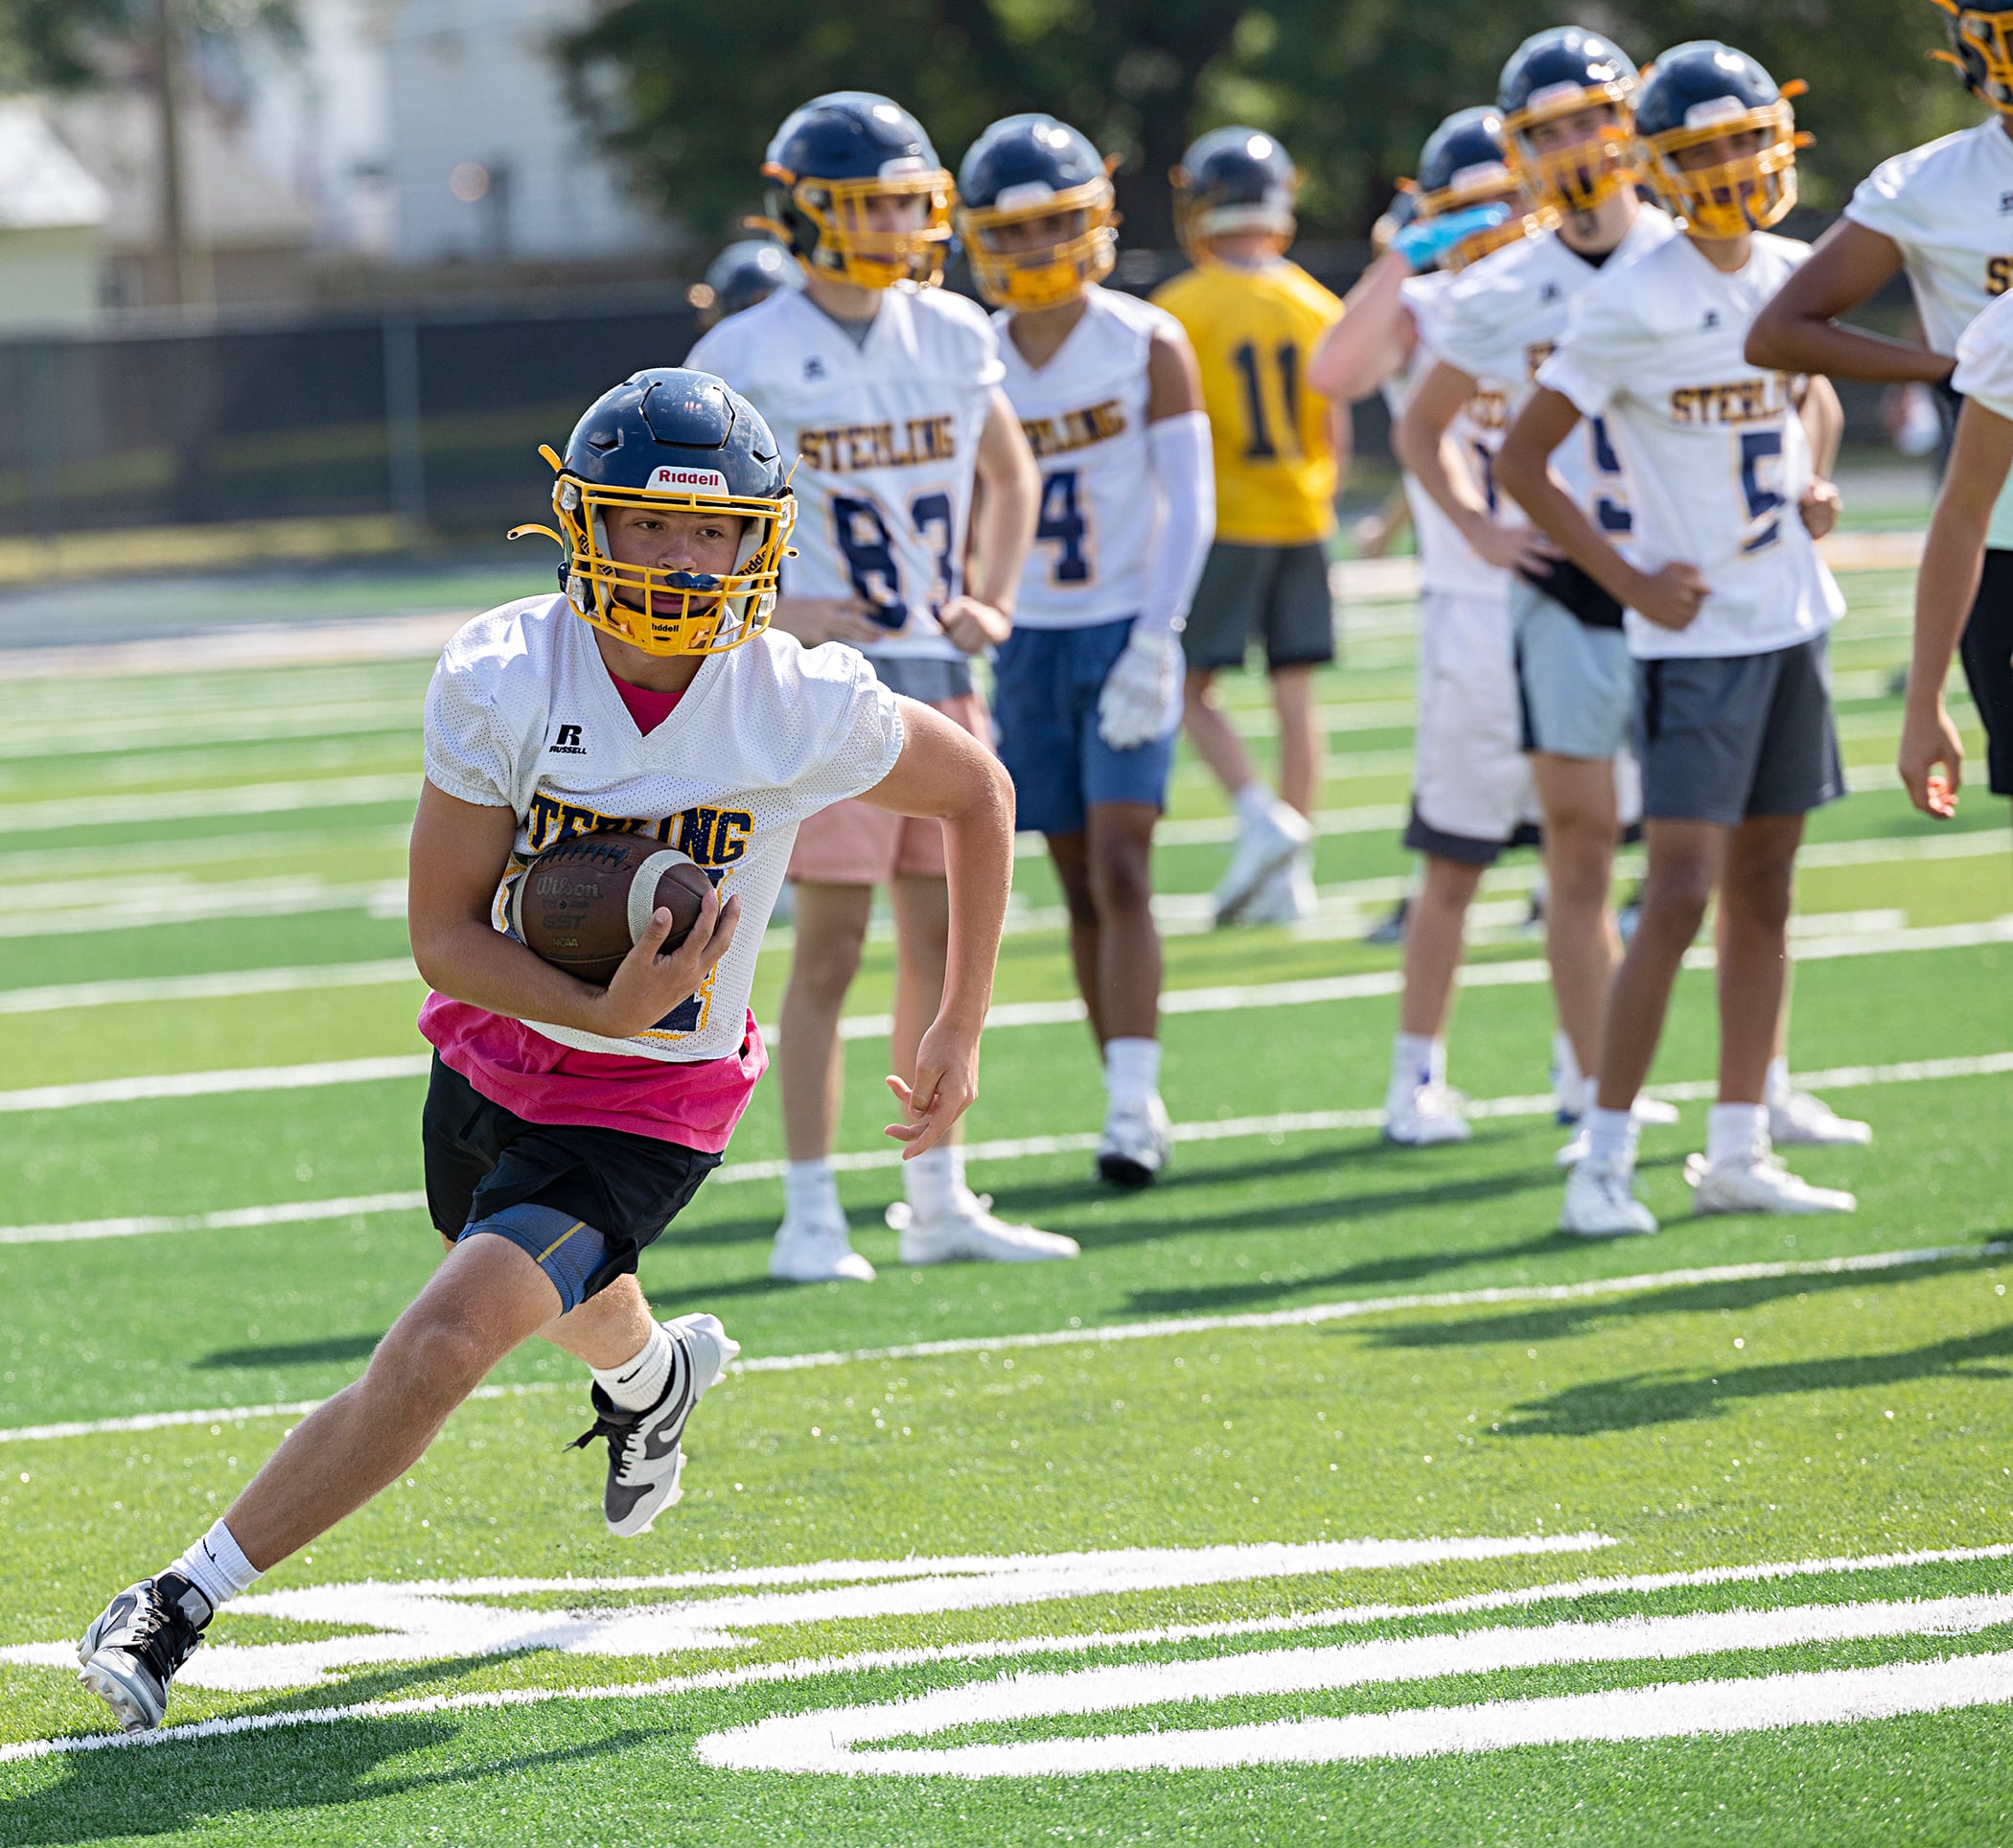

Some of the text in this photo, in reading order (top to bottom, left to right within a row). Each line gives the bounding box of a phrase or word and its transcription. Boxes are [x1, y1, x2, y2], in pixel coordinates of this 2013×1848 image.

[659, 469, 719, 487] Riddell
[1731, 424, 1791, 560] 5
[548, 746, 588, 755] RUSSELL
[536, 874, 604, 898] Wilson
